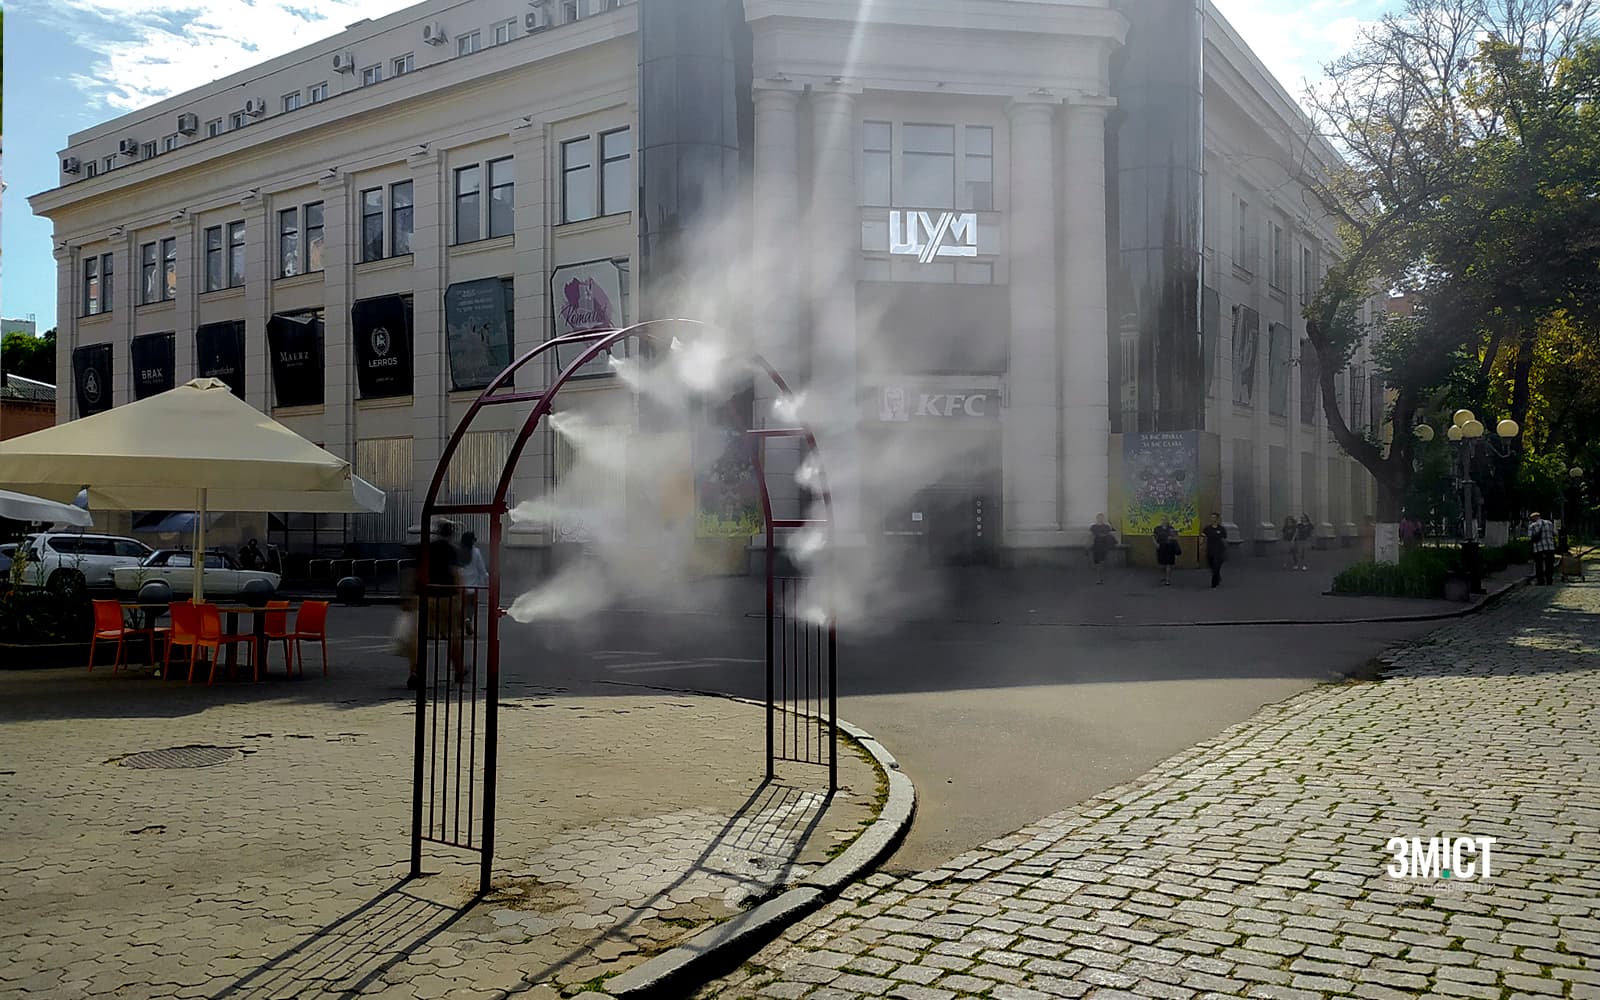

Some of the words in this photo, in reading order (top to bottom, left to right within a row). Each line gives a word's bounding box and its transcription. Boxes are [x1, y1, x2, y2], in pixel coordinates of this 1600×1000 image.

[889, 210, 978, 263] ЦУМ
[368, 357, 398, 368] LERROS
[141, 368, 163, 380] BRAX
[915, 394, 987, 417] KFC
